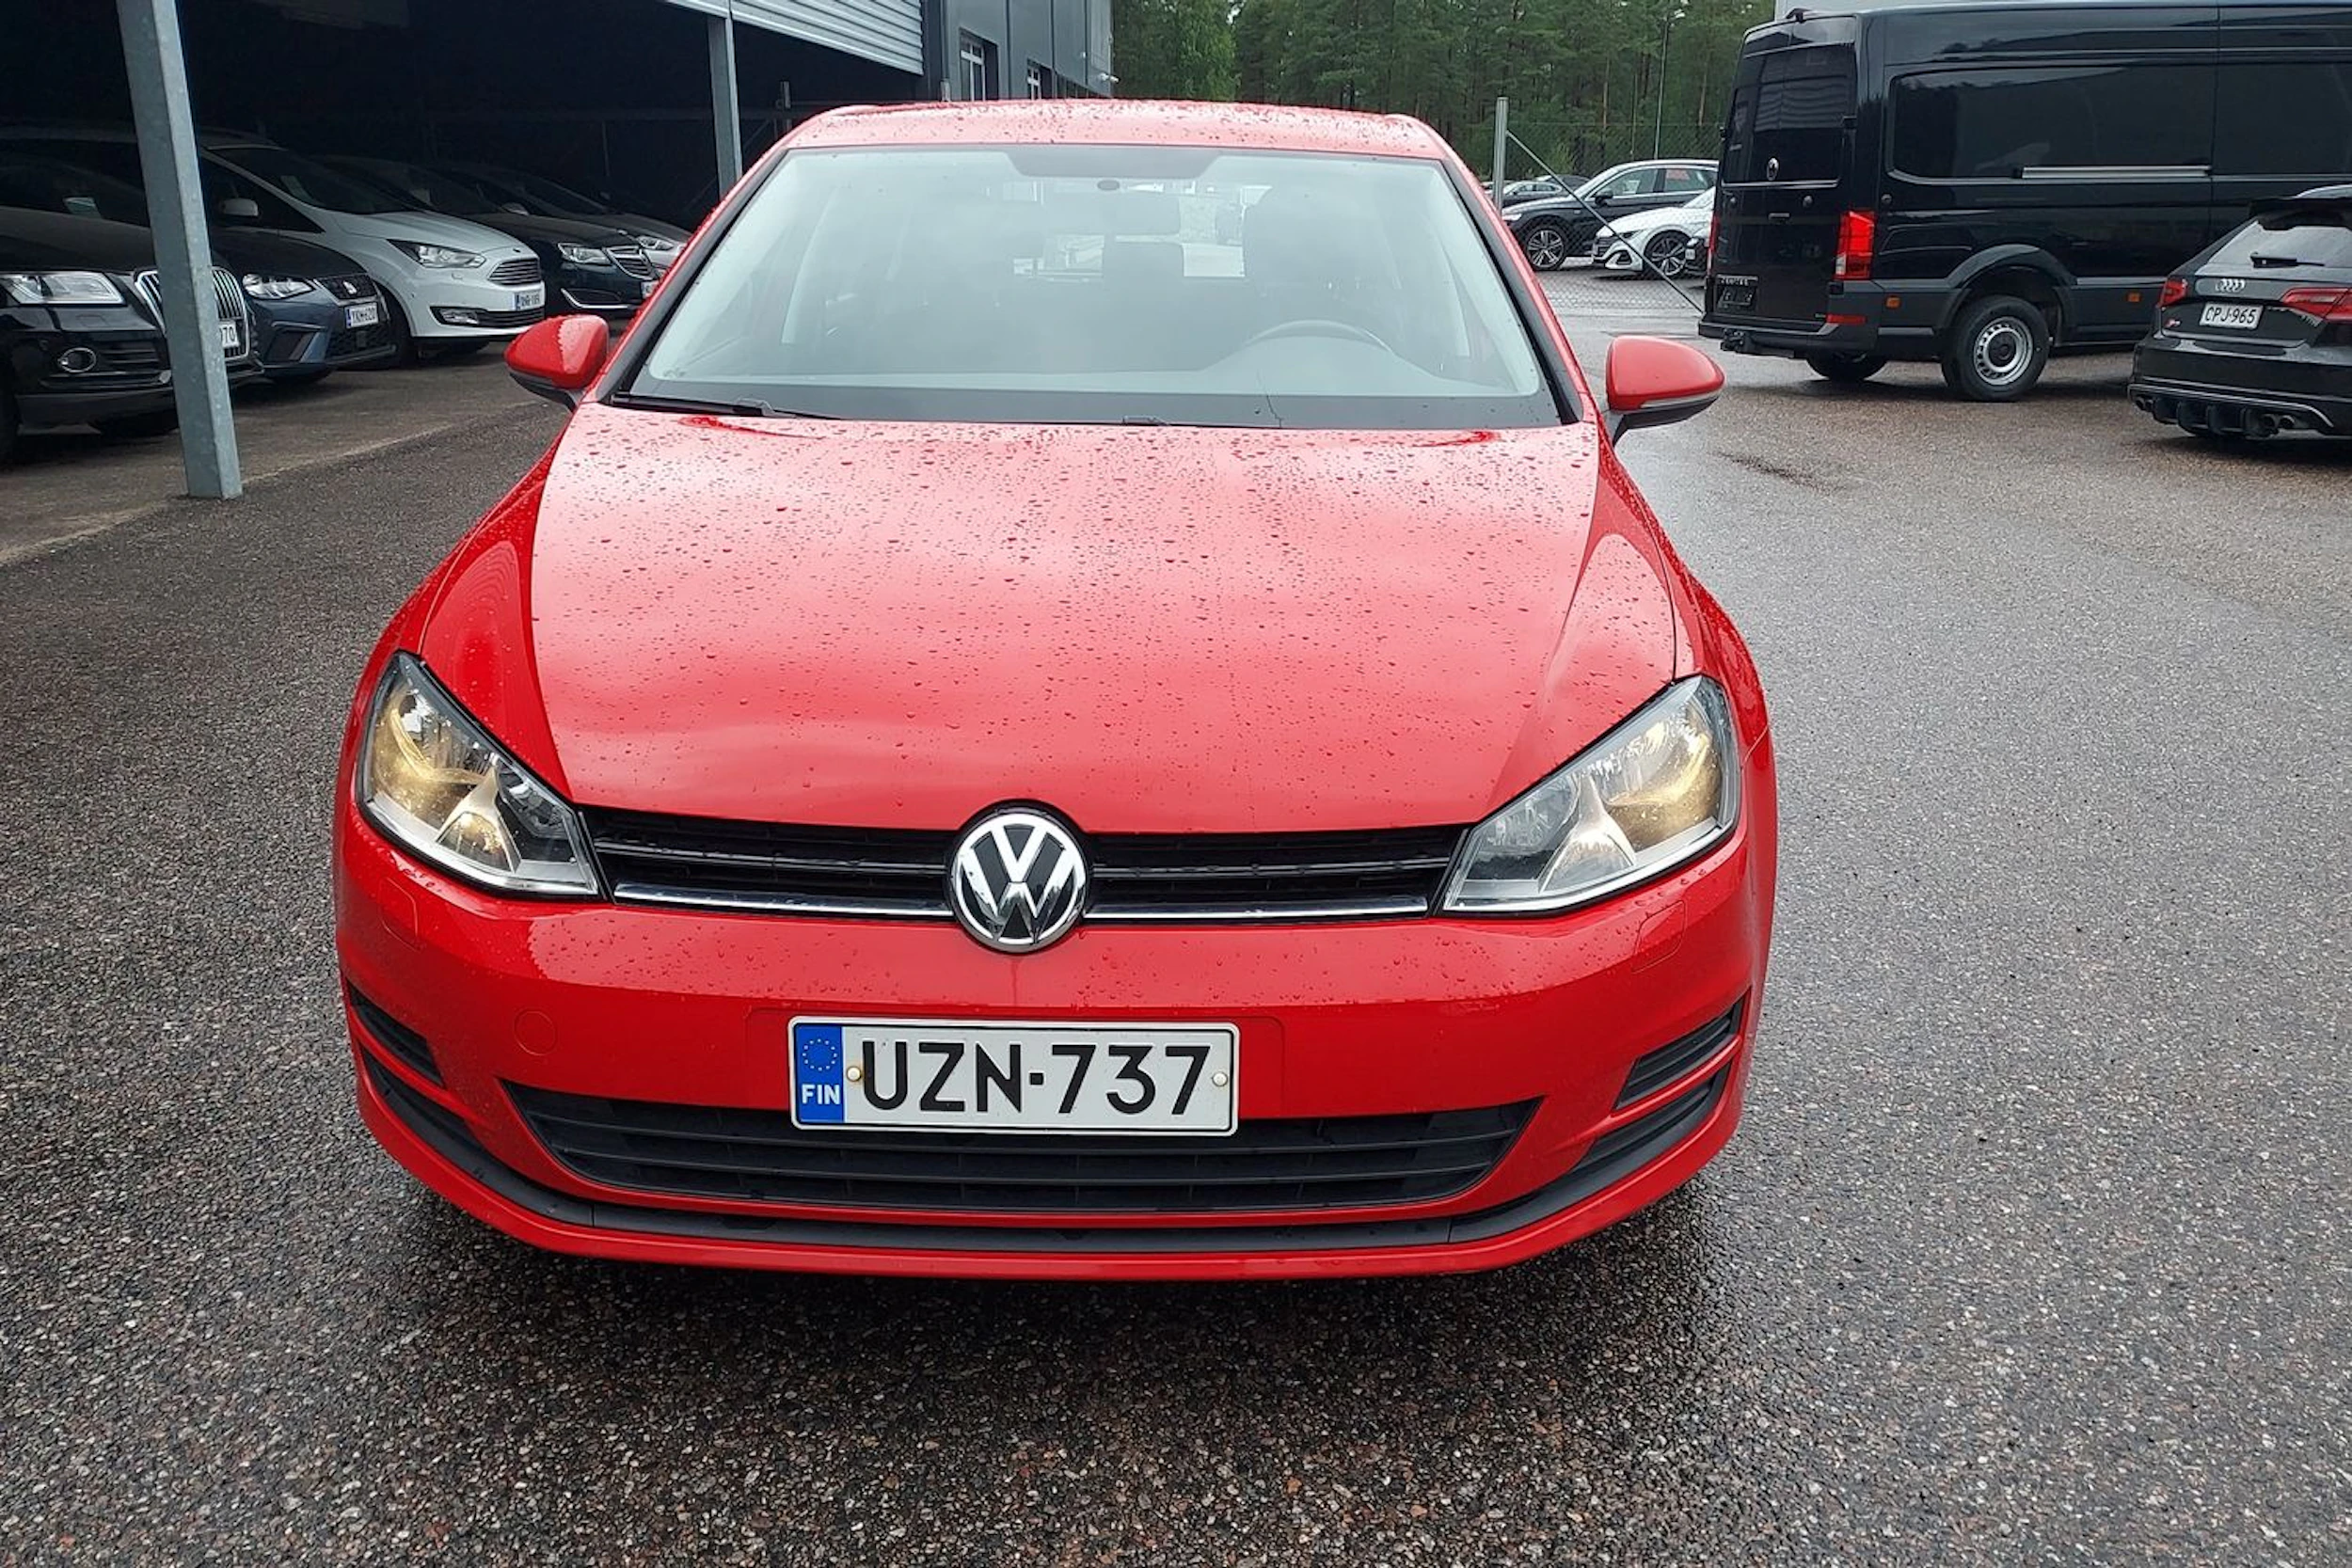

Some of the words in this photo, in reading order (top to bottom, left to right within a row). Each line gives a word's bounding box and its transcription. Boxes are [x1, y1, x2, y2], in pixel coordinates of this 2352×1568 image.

[2204, 306, 2257, 325] CPJ-965
[861, 1040, 1212, 1116] UZN-737
[801, 1084, 842, 1106] FIN
